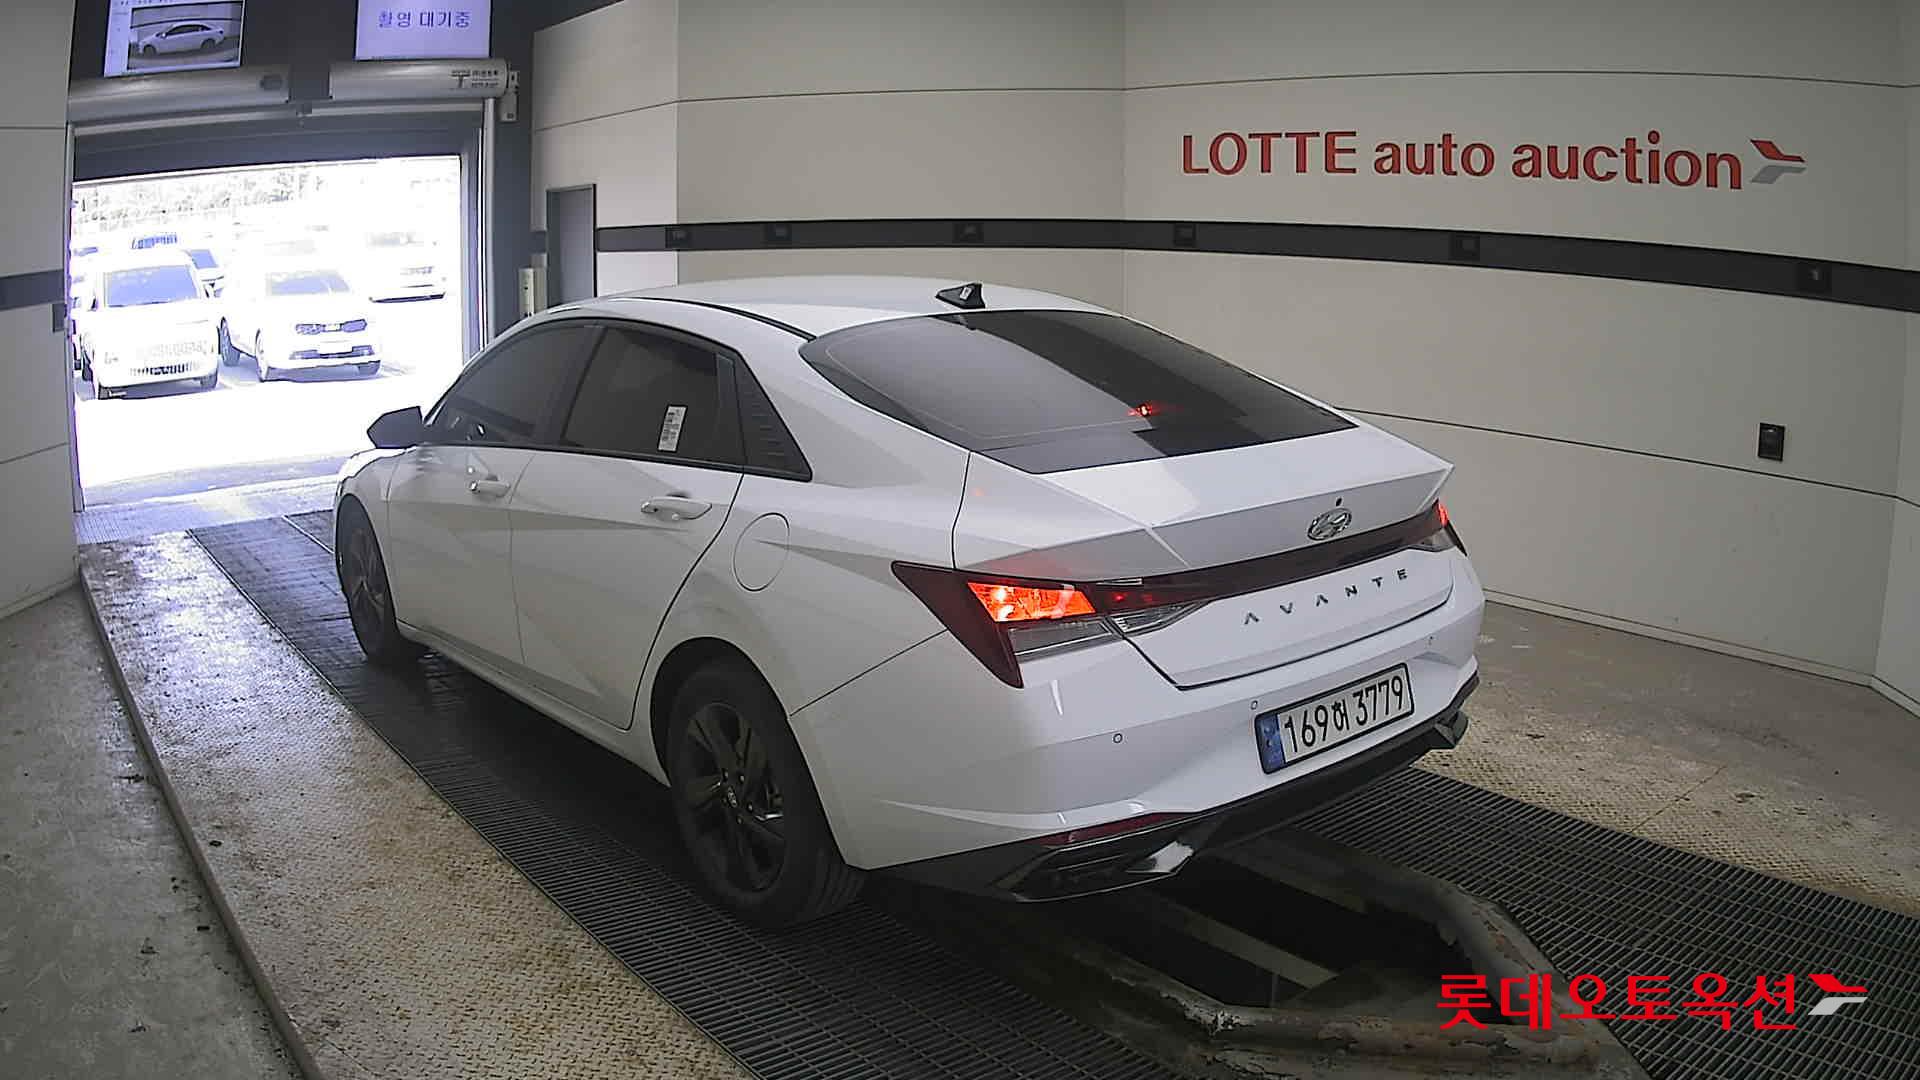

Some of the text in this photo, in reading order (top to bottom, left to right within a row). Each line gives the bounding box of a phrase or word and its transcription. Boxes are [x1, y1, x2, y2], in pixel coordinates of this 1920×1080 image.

[420, 11, 471, 28] 대기중
[1182, 130, 1743, 190] LOTTE auto auction
[1243, 568, 1409, 625] AVANTE
[1352, 675, 1404, 727] 3779
